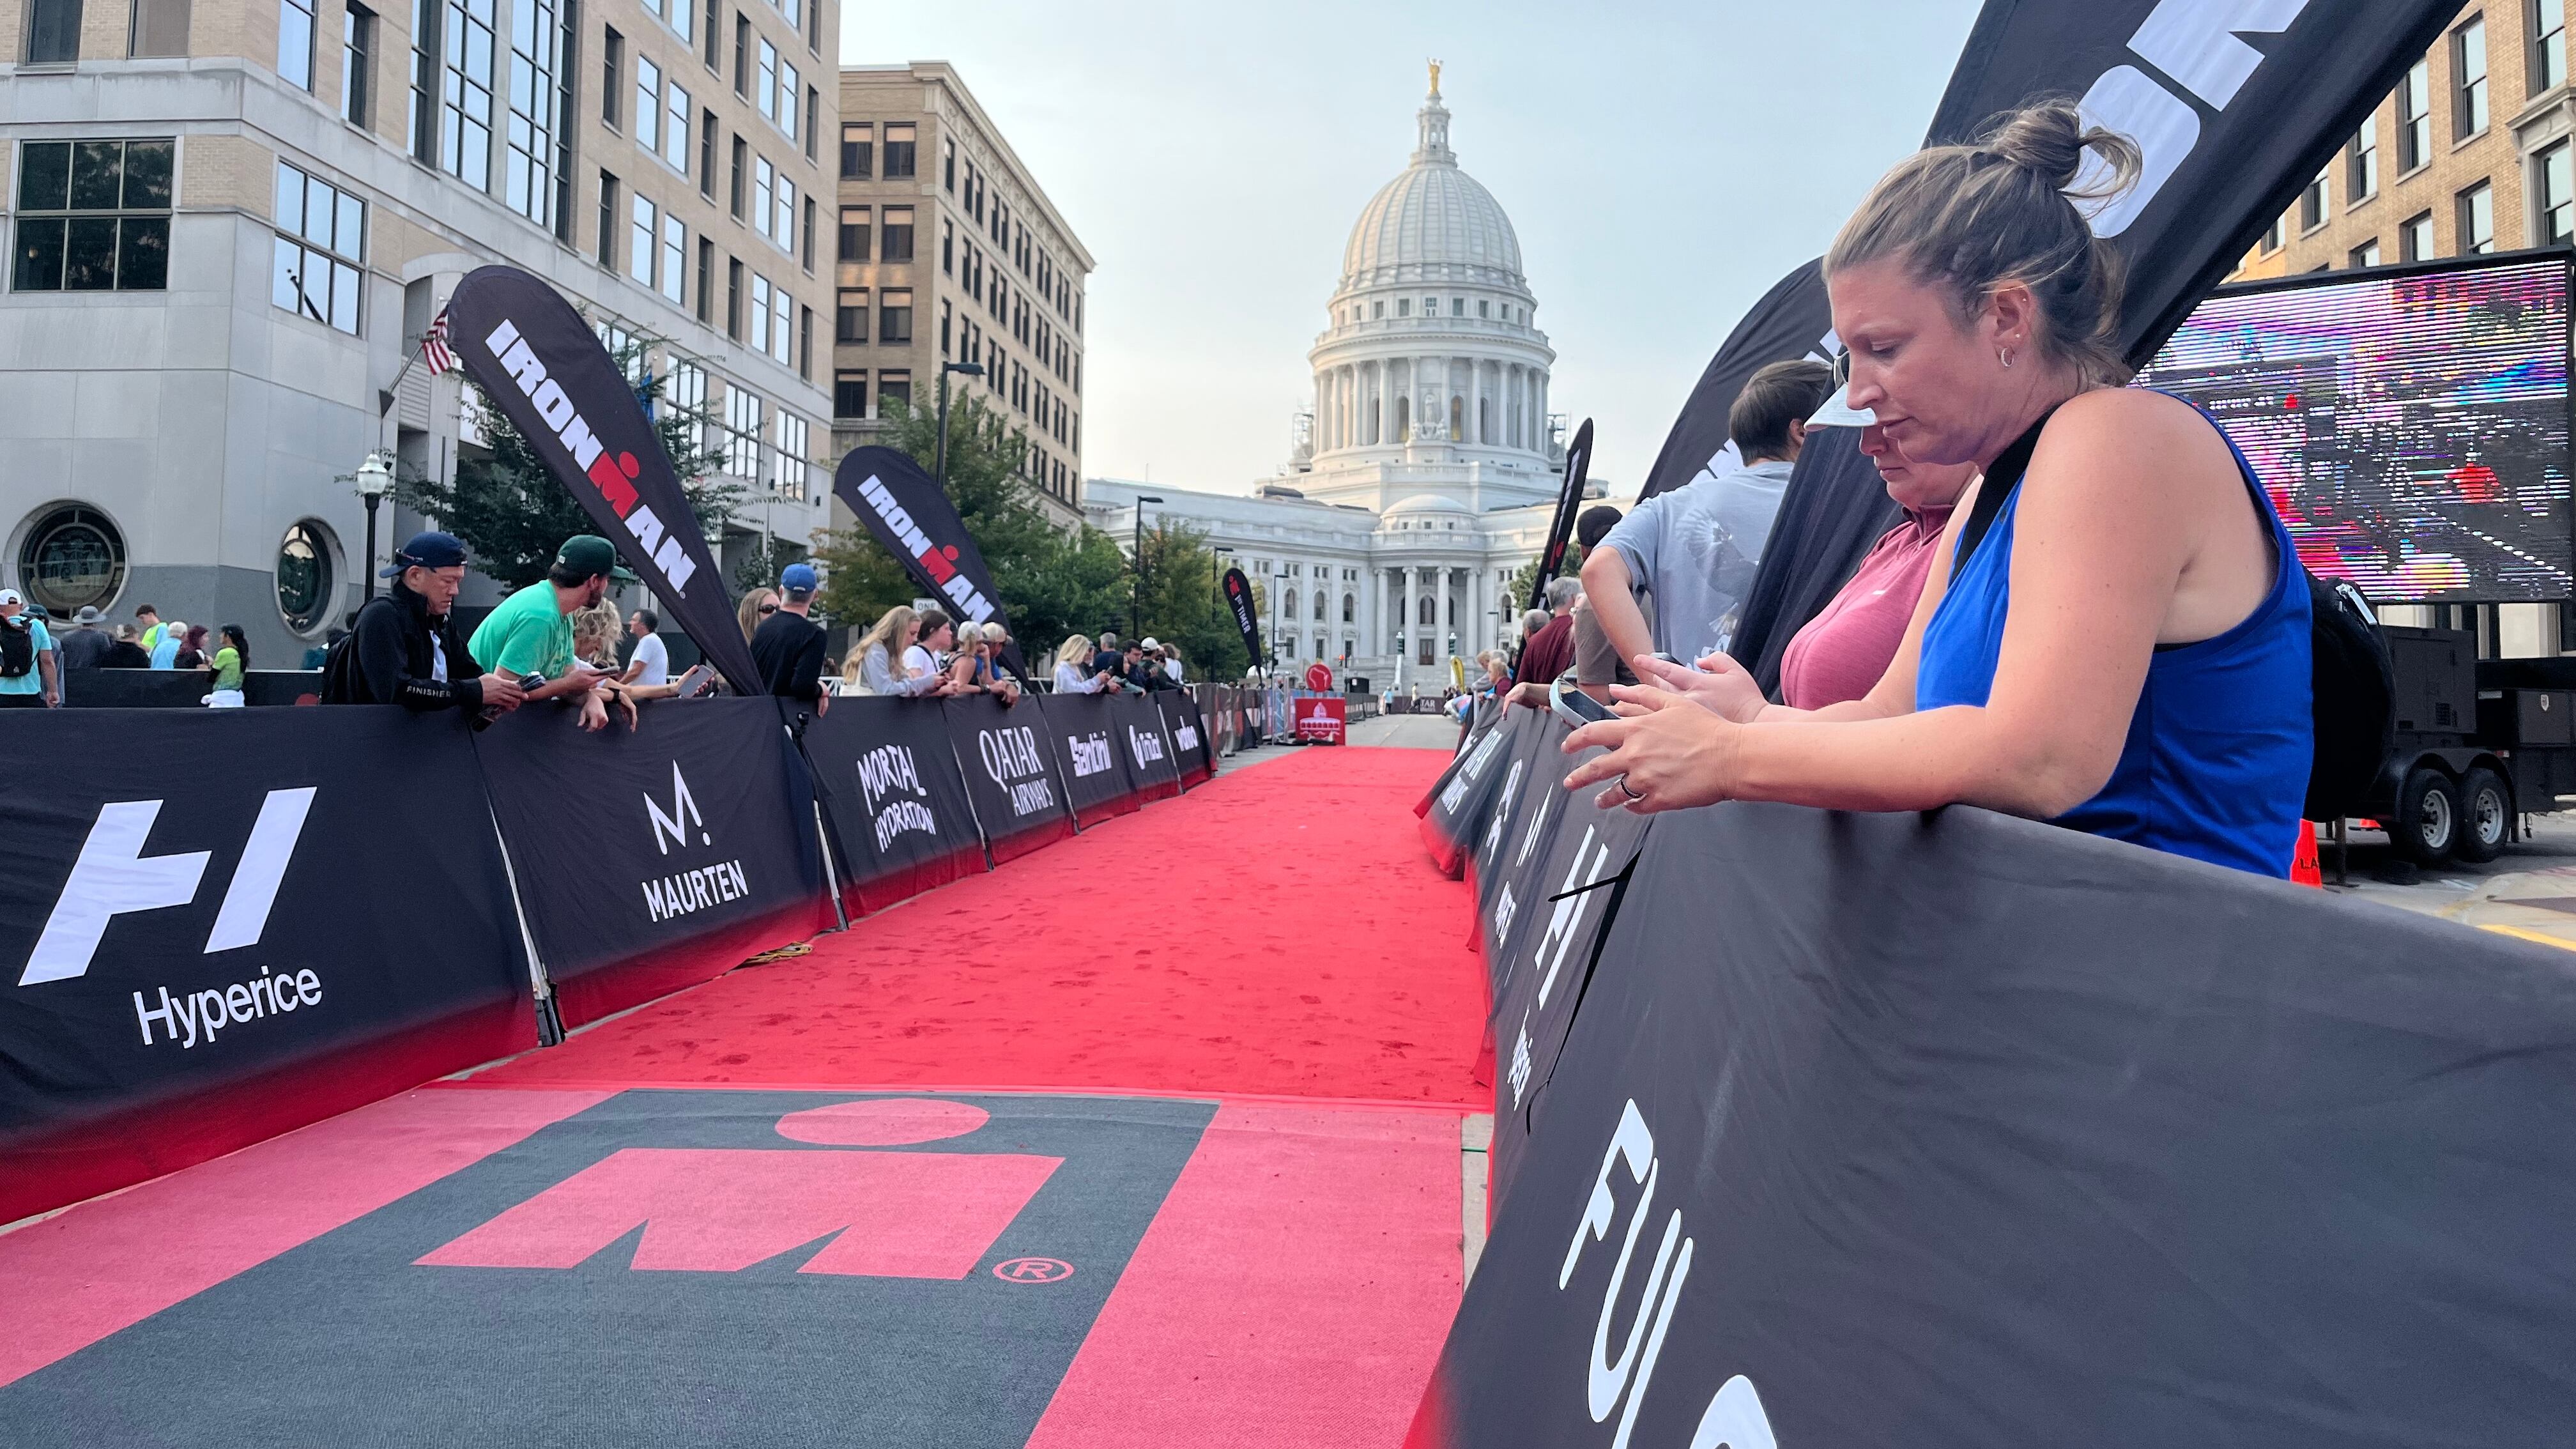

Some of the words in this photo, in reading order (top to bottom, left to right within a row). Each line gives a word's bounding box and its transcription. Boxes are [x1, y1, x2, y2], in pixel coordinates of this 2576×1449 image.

[484, 318, 697, 594] IRONMAN
[857, 473, 996, 624] IRONMAN
[1238, 605, 1251, 634] TIMER
[406, 686, 451, 698] FINISHER
[857, 744, 927, 816] MORTAL
[979, 725, 1044, 793] QATAR
[1068, 730, 1112, 778] Santini
[875, 799, 937, 853] HYDRATION
[1008, 778, 1054, 817] AIRWAYS
[641, 859, 749, 923] MAURTEN
[133, 965, 323, 1049] Hyperice
